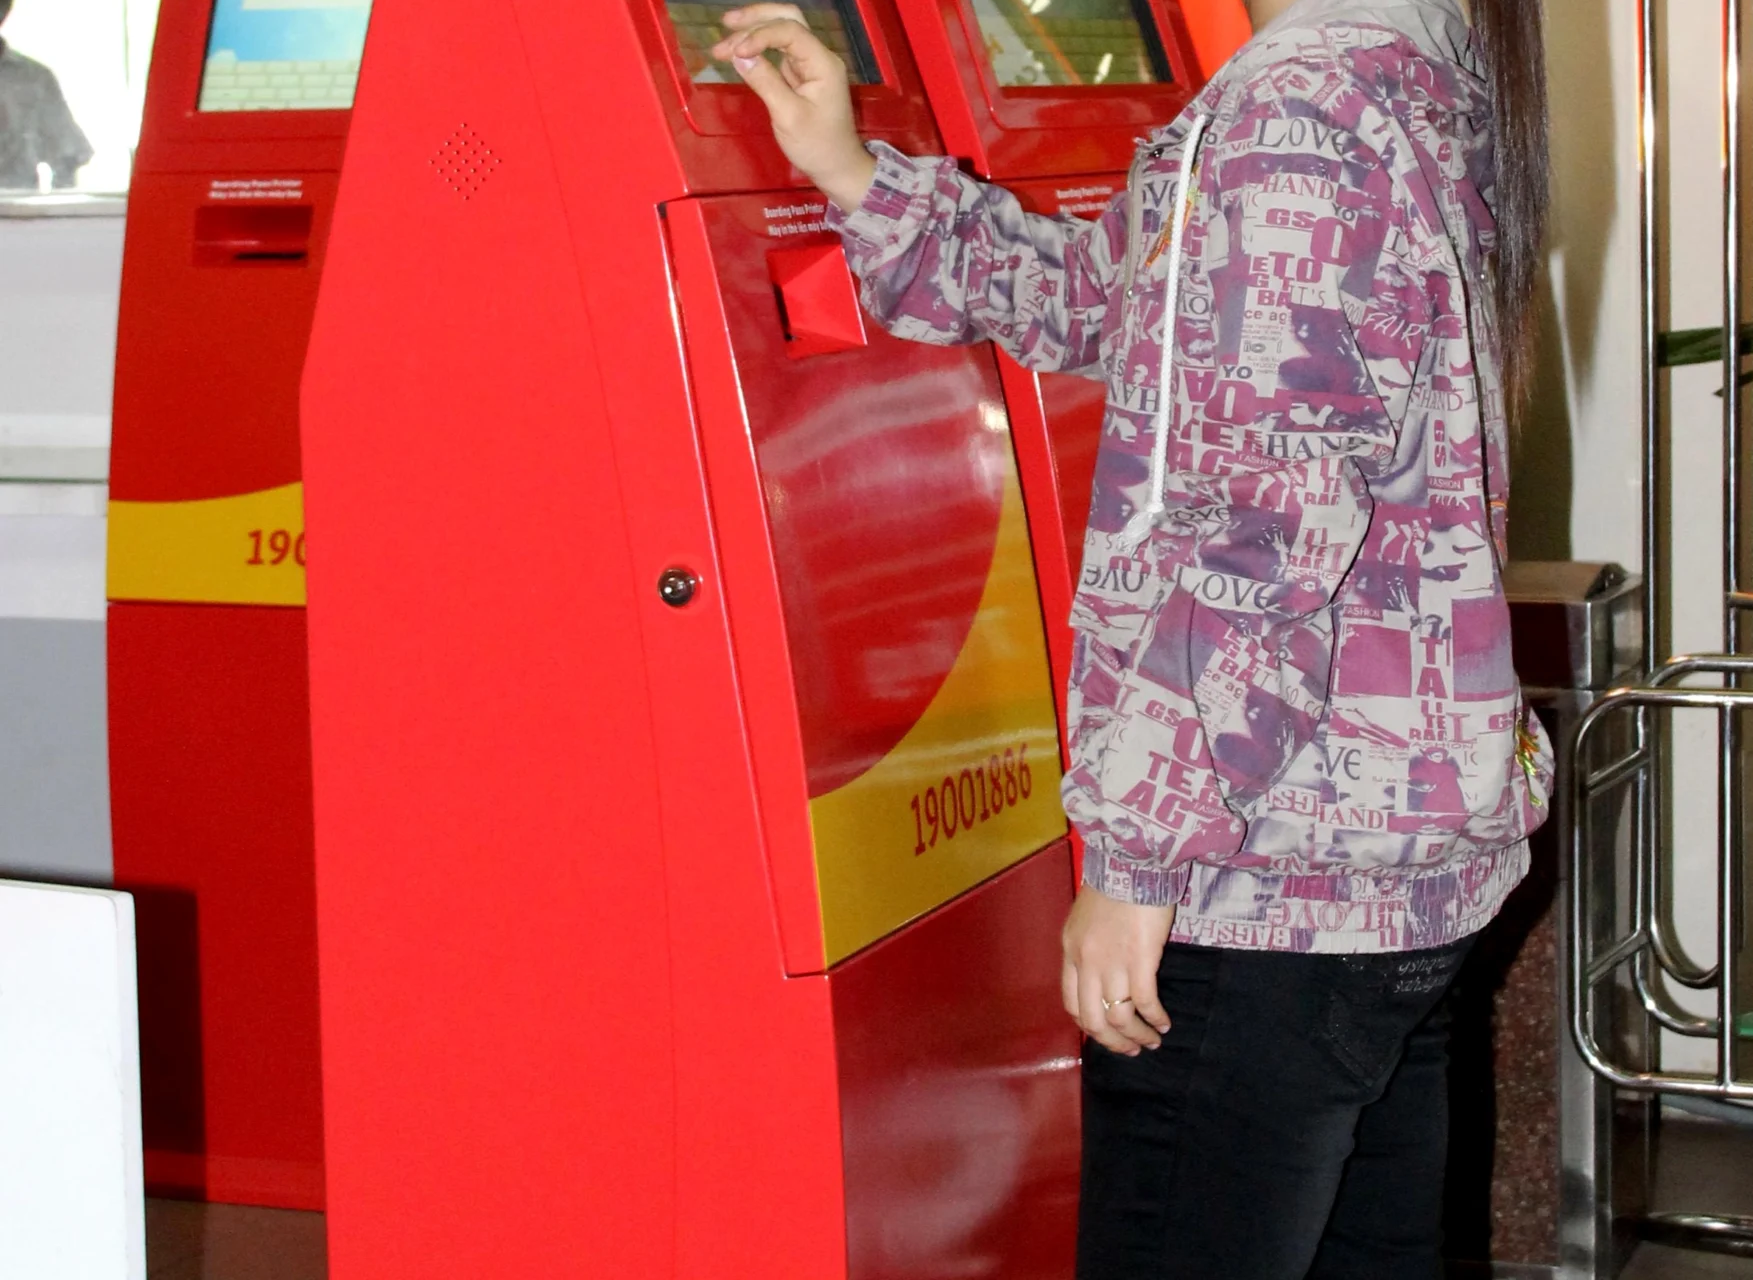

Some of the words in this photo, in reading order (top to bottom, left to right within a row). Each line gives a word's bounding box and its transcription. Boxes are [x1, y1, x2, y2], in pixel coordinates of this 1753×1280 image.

[1262, 173, 1335, 200] HAND
[1363, 312, 1422, 350] FAIR
[910, 741, 1032, 857] 19001886
